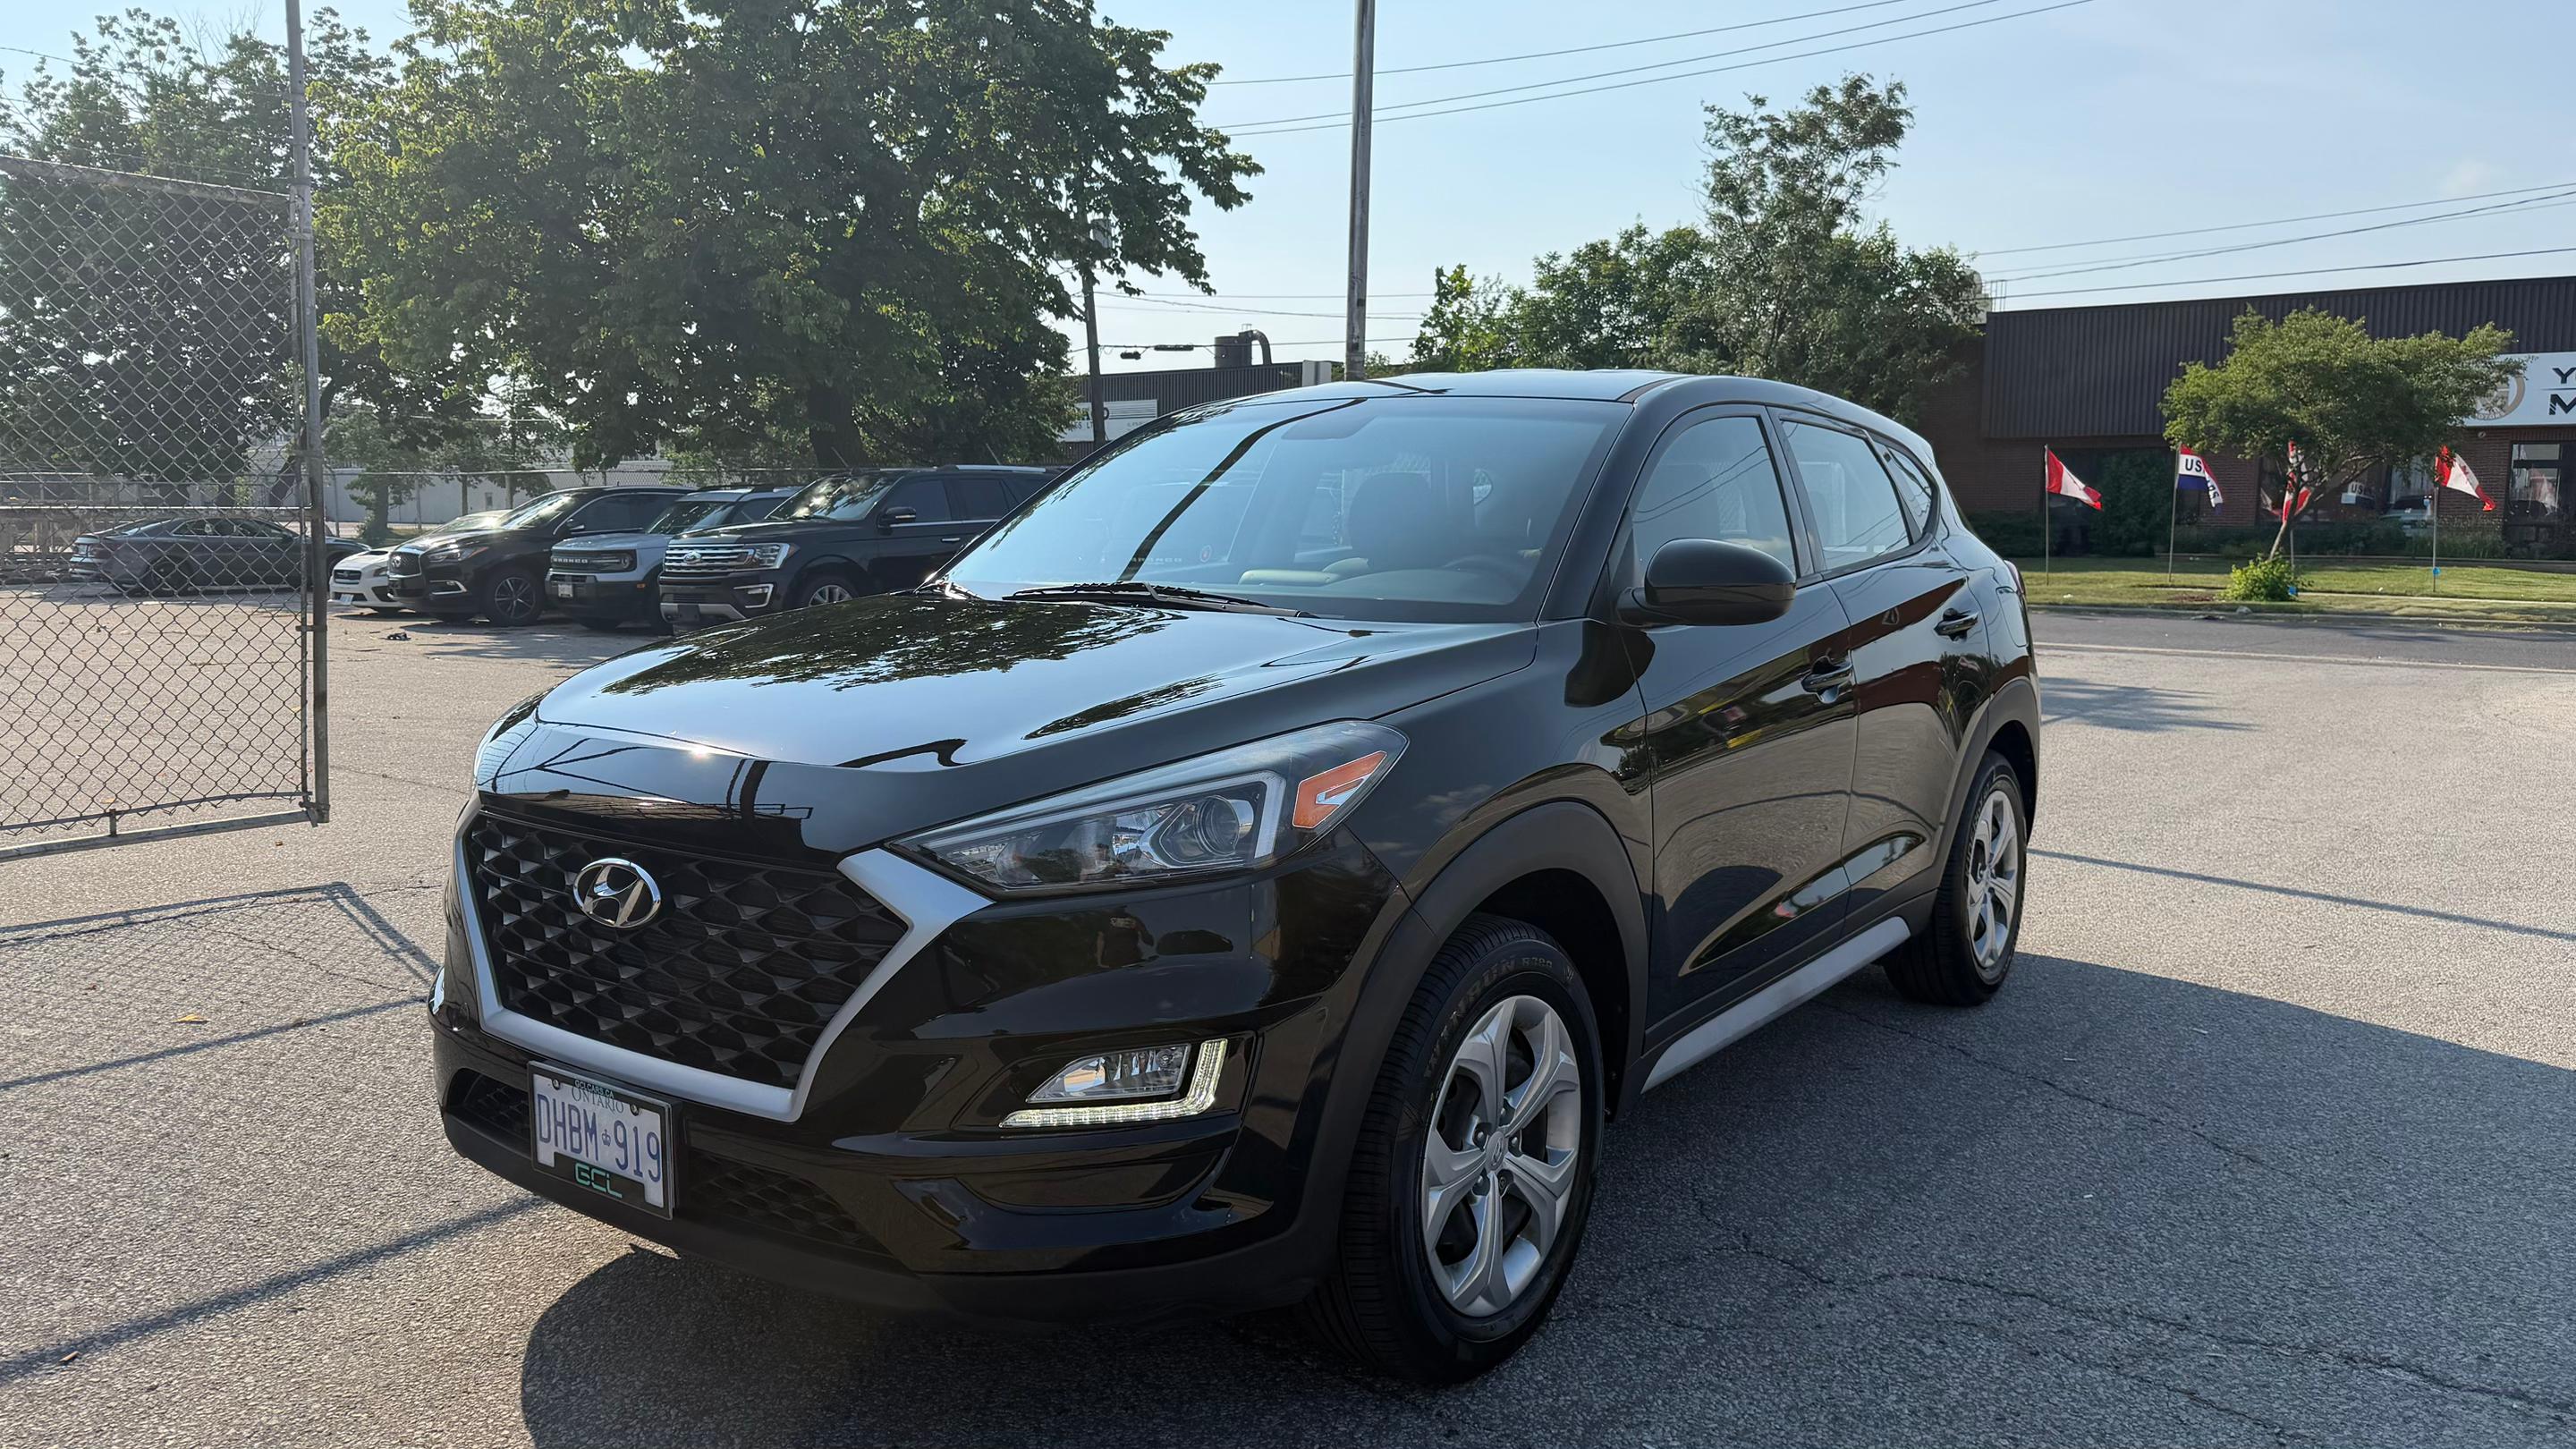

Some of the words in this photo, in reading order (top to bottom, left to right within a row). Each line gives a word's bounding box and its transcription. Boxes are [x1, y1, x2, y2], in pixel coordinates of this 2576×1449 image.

[572, 1086, 624, 1114] ONTARIO
[538, 1094, 598, 1161] DHBM
[614, 1120, 660, 1182] 919
